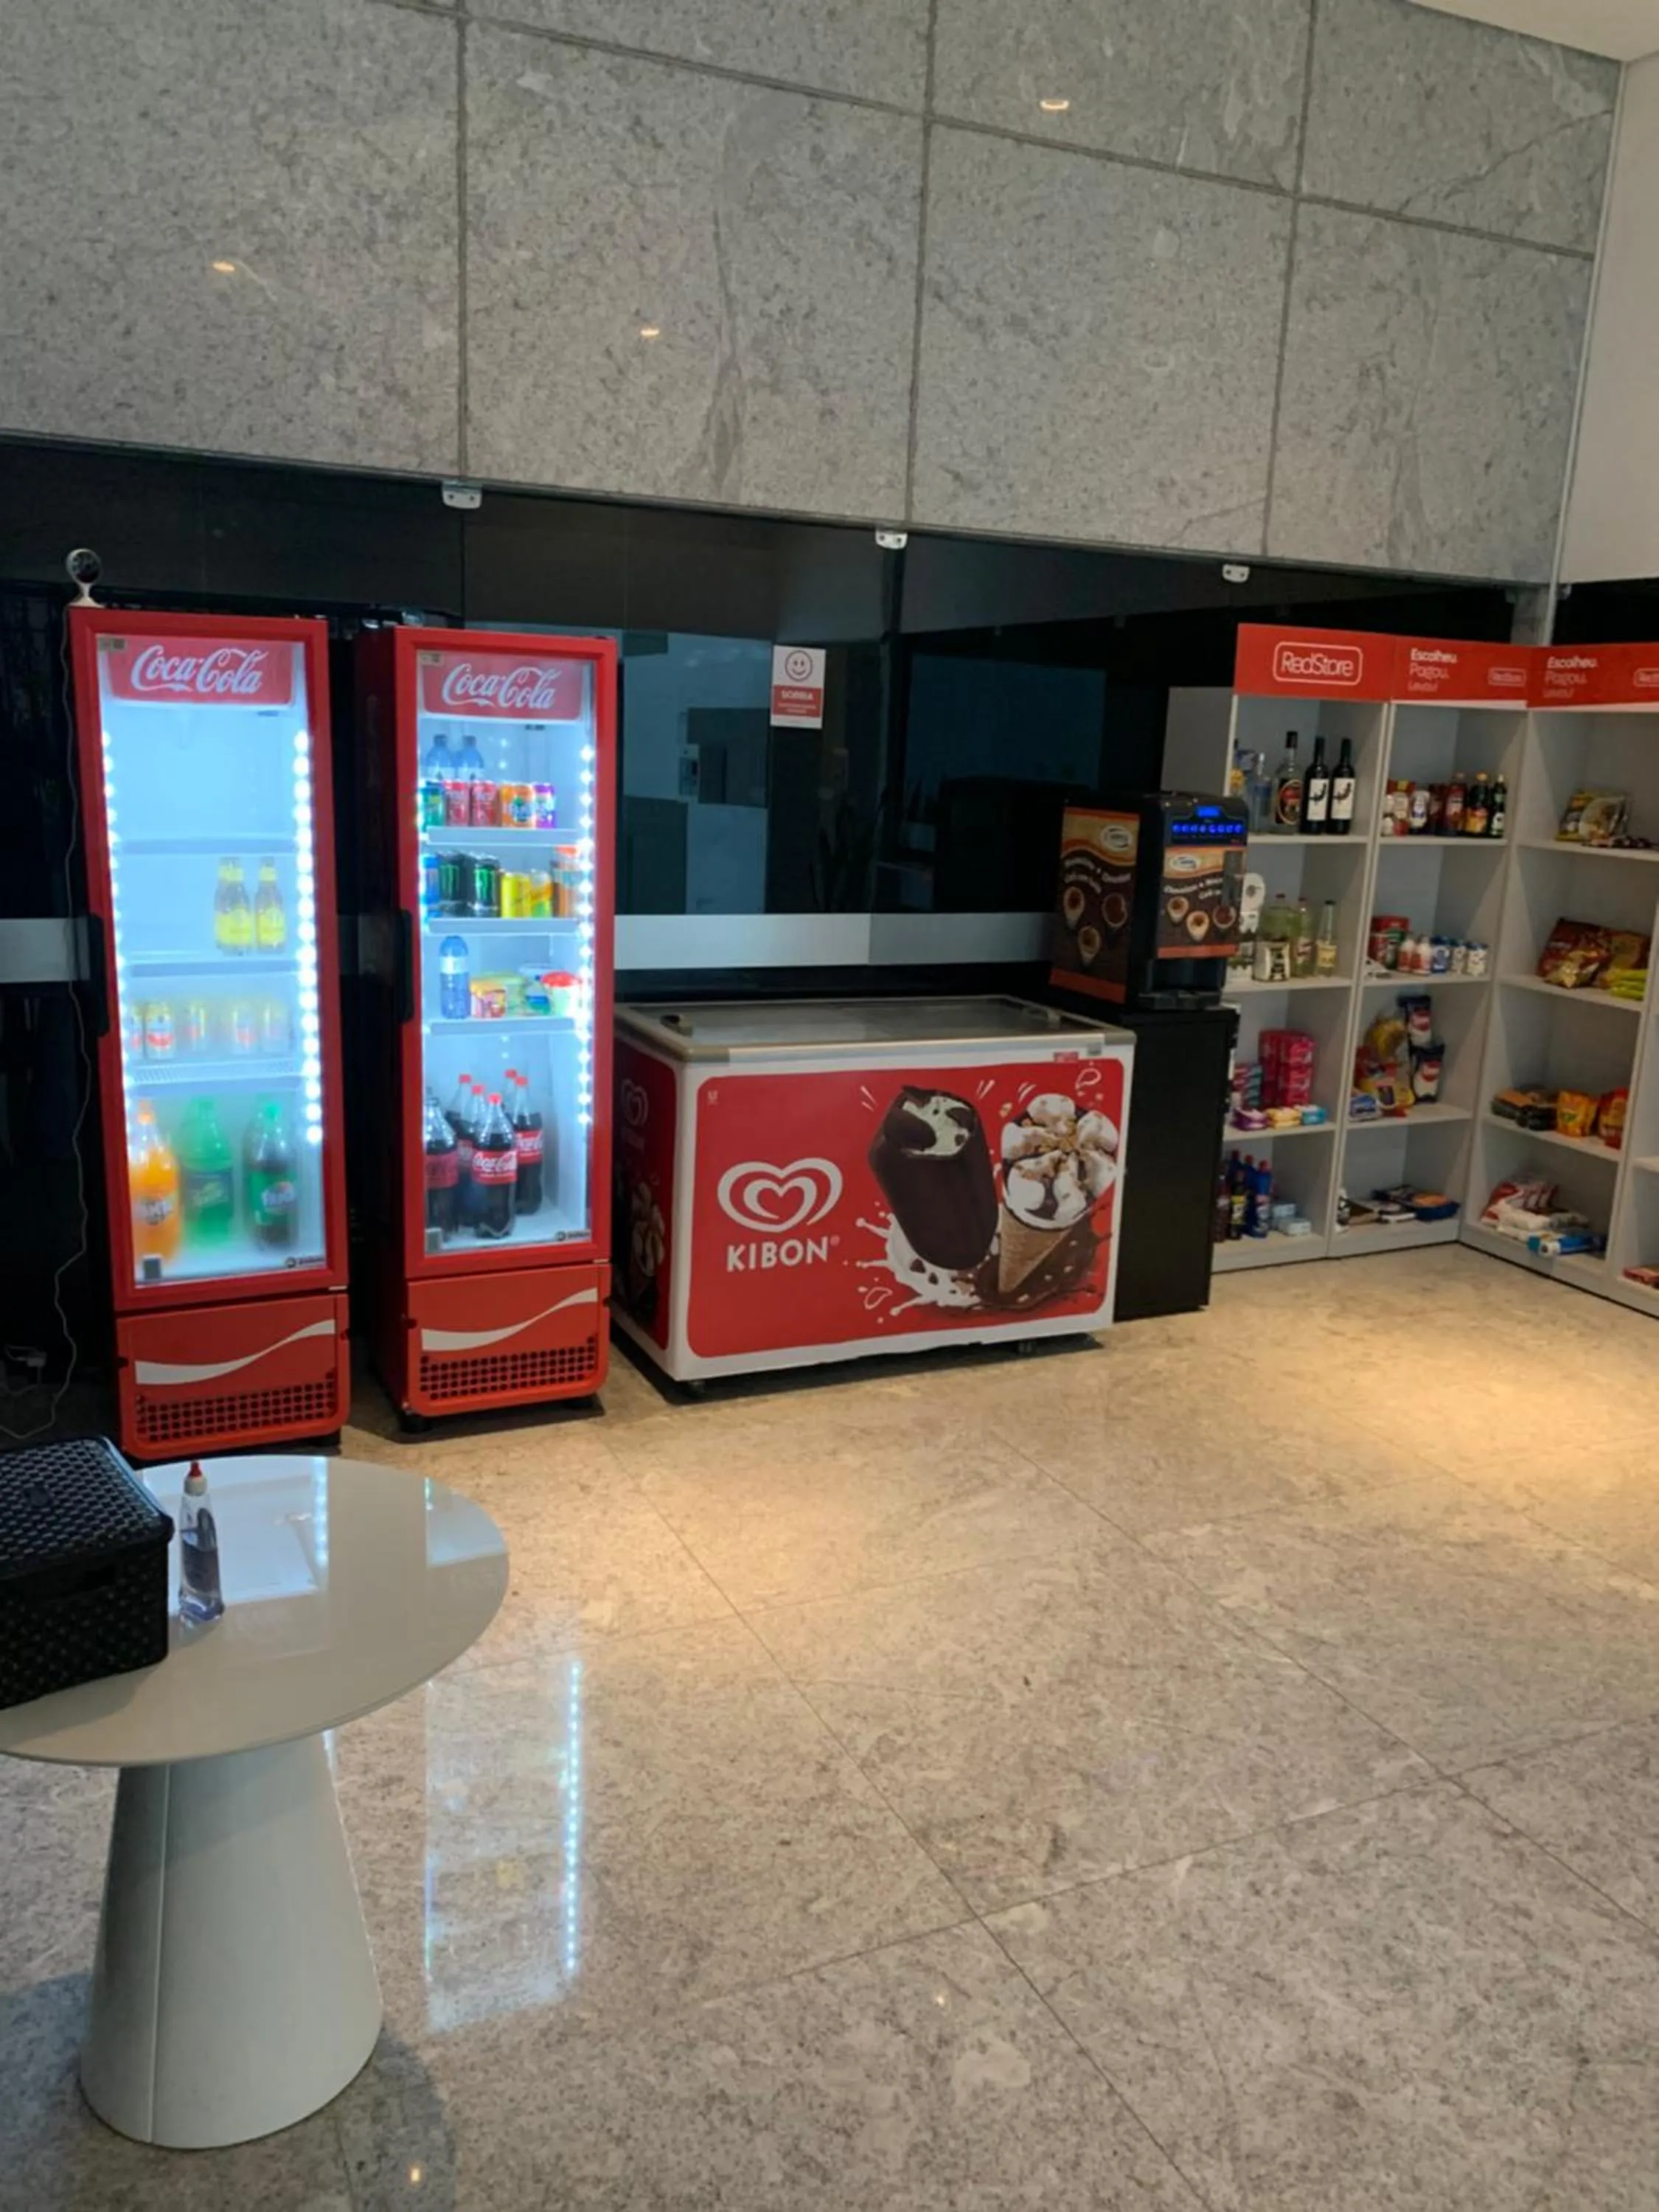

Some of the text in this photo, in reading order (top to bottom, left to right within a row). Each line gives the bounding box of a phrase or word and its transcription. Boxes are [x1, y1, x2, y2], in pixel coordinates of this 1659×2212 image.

[131, 644, 269, 694] Coca-Cola
[1281, 650, 1354, 677] RedStore
[442, 663, 562, 709] Coca-Cola
[726, 1235, 829, 1273] KIBON
